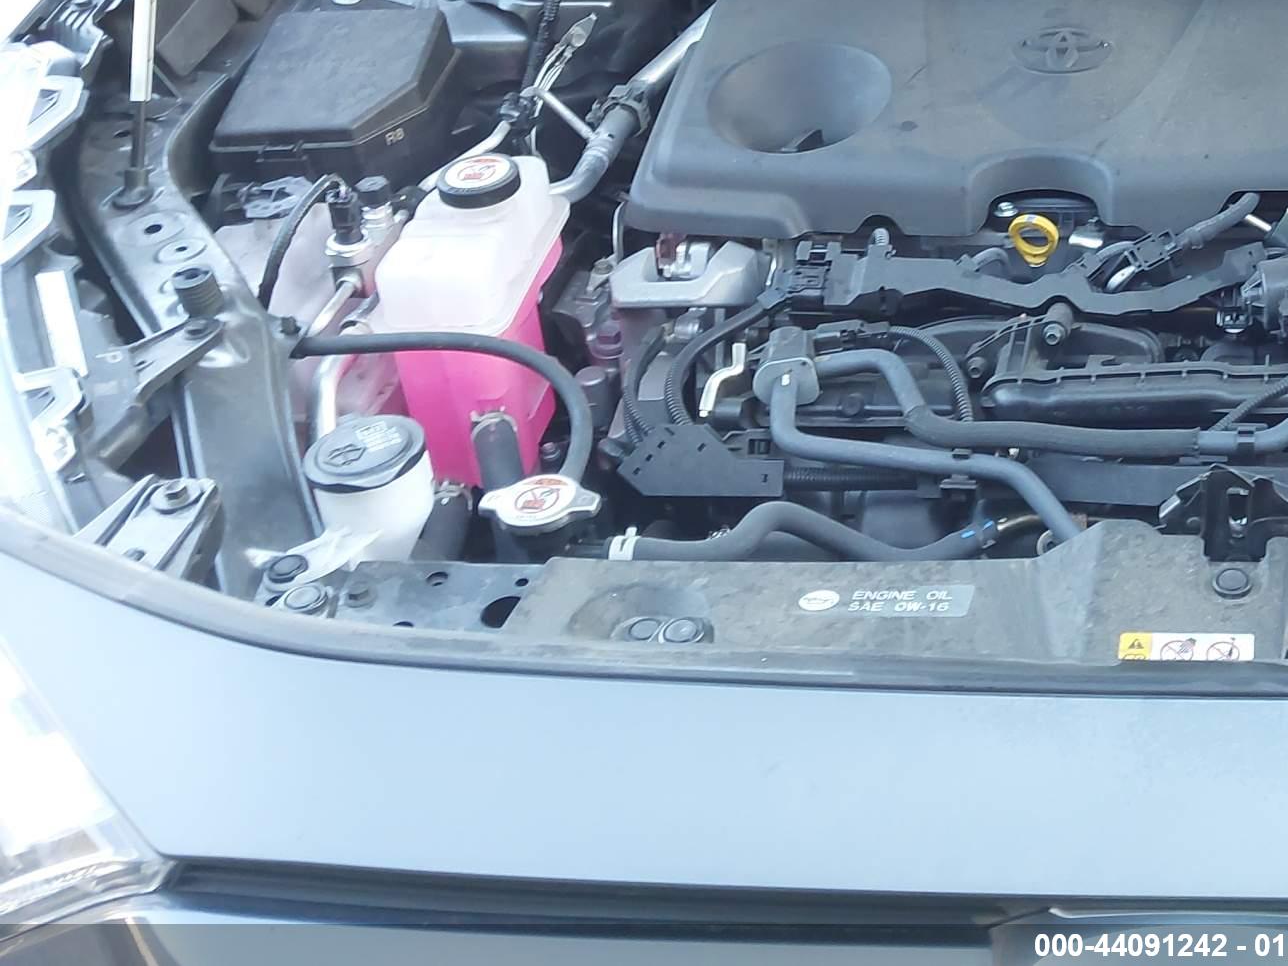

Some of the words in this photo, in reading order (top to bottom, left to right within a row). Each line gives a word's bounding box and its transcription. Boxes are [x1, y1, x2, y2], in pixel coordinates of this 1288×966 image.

[852, 590, 917, 601] ENGINE
[926, 590, 953, 601] OIL
[848, 601, 885, 612] SAE
[894, 601, 950, 612] 0W-16
